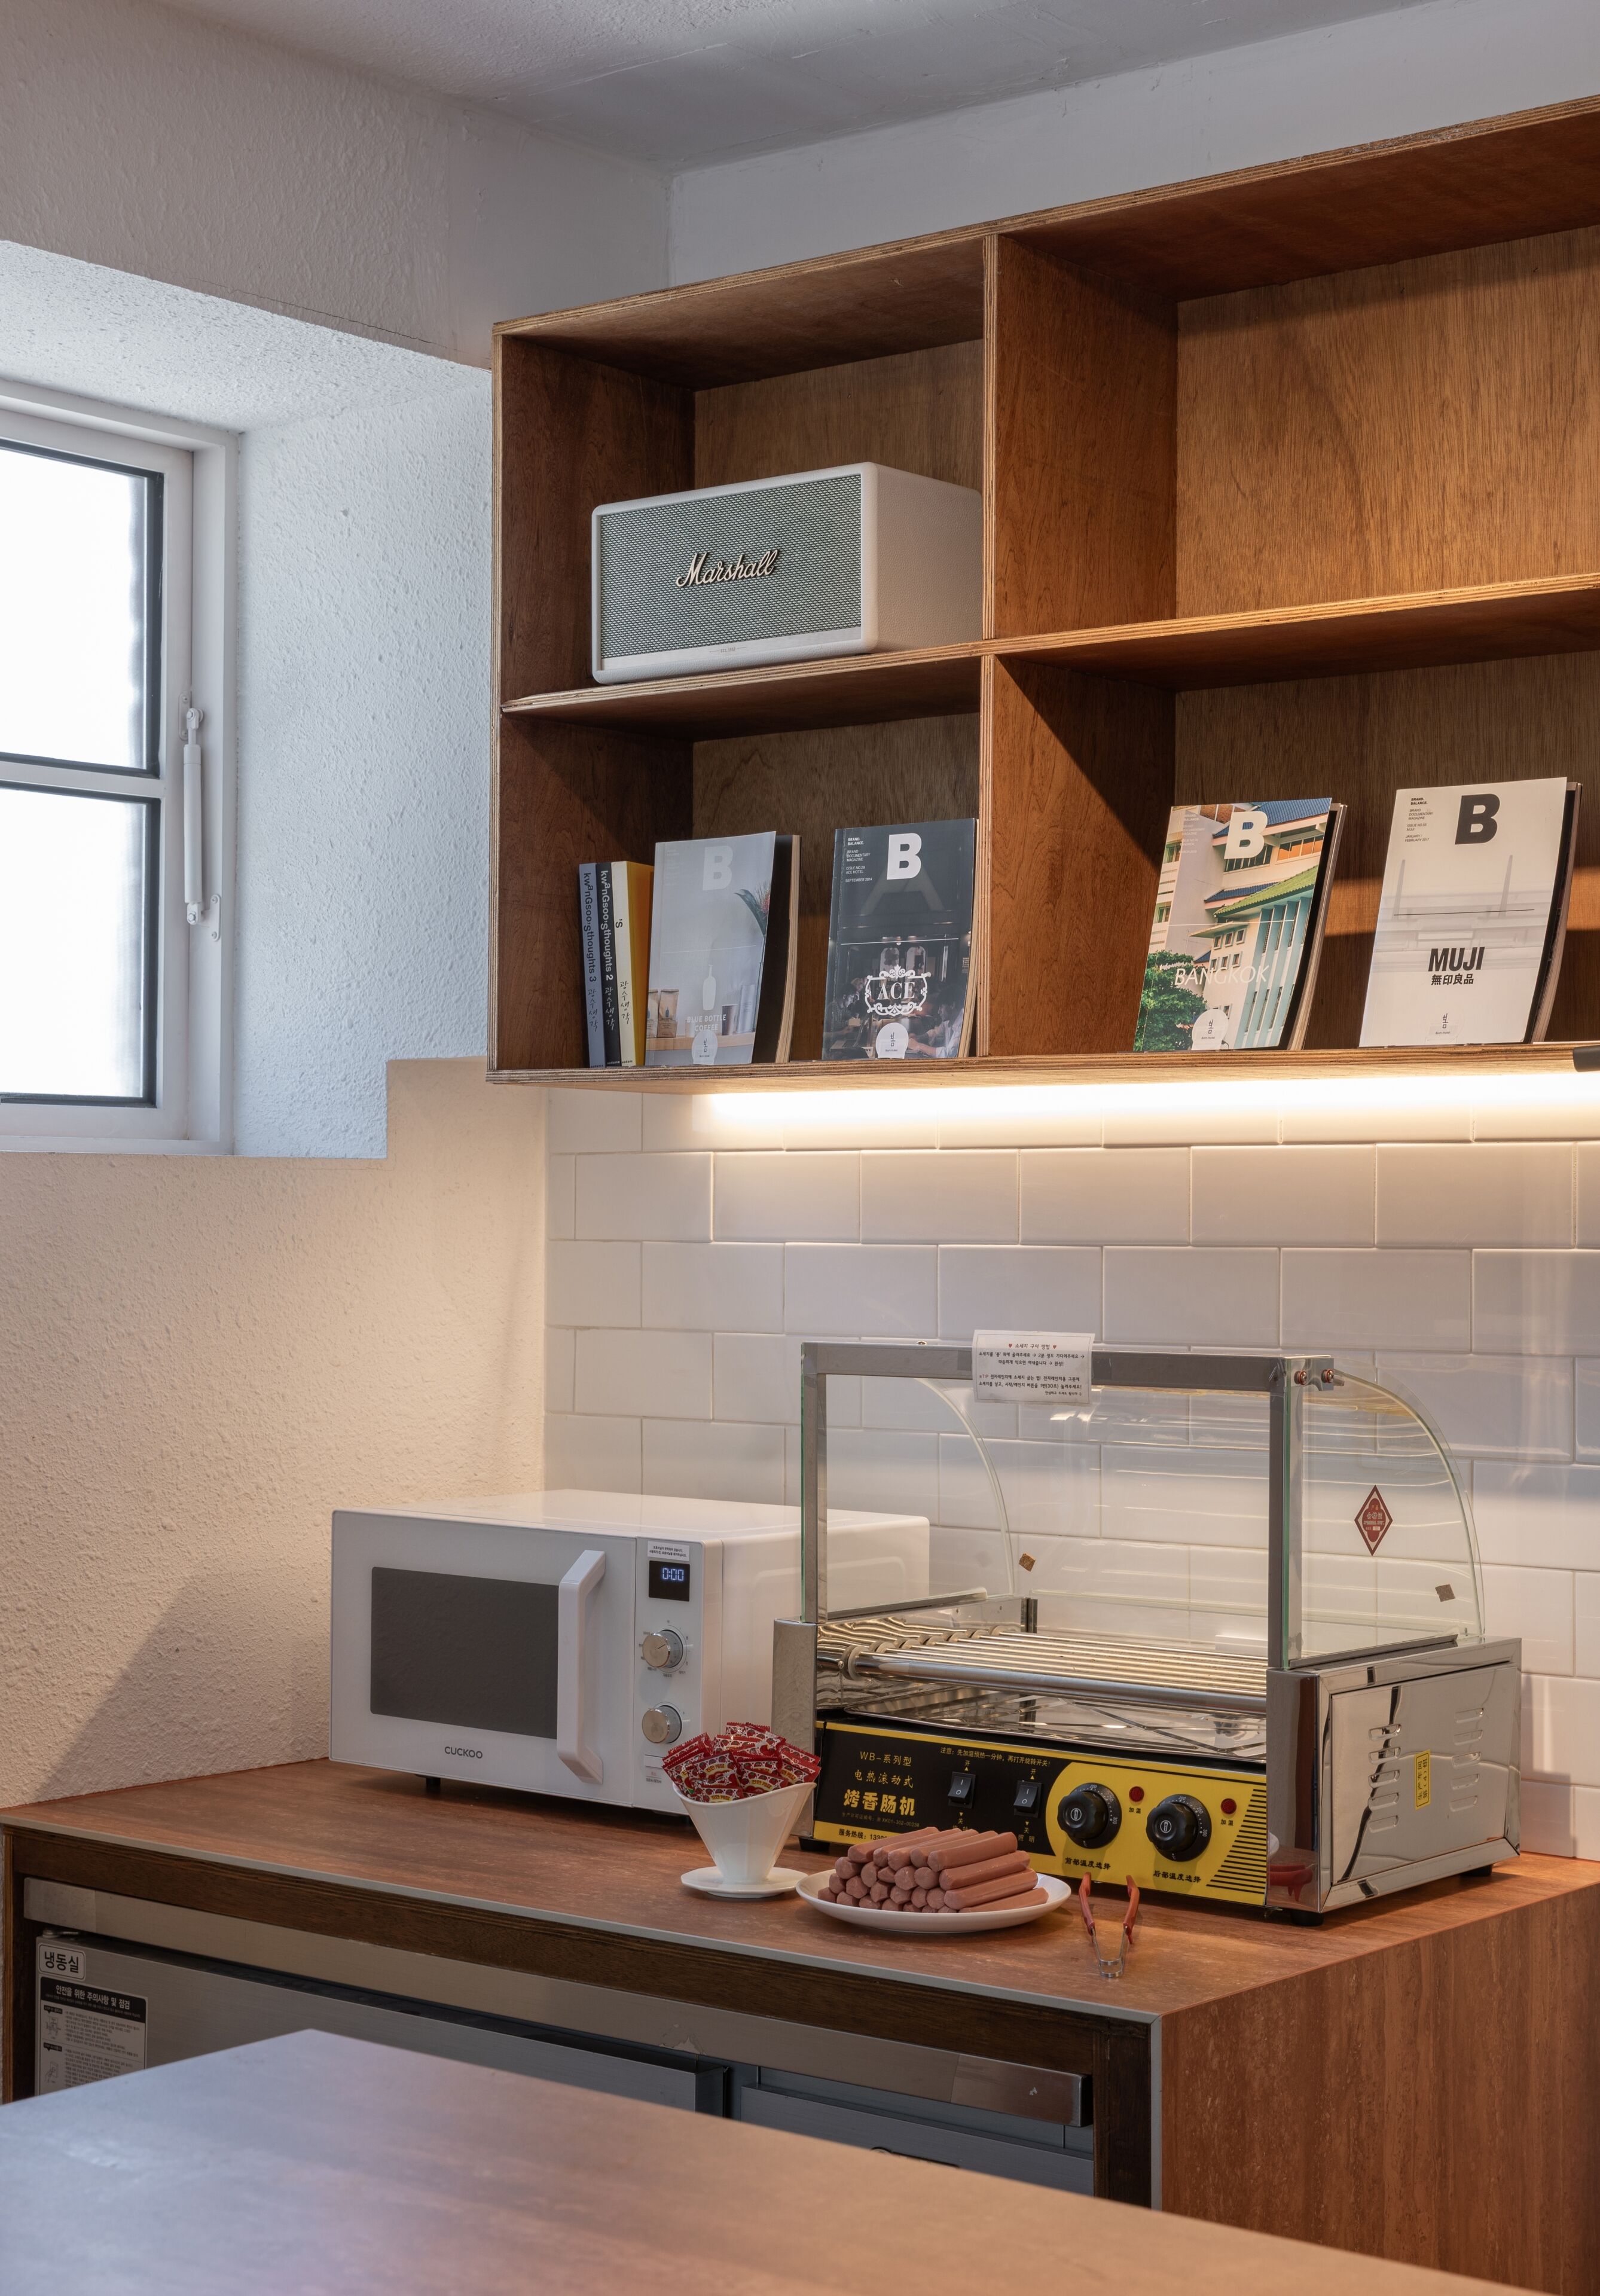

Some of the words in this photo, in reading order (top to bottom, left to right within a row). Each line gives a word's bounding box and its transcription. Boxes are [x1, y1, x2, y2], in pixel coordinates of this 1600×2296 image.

[676, 549, 778, 588] Marshall
[1455, 793, 1500, 845] B
[1224, 811, 1268, 859] B
[887, 832, 922, 880] B
[703, 845, 733, 891] B
[1427, 947, 1485, 972] MUJI
[1174, 965, 1269, 985] BANGKOK
[1431, 973, 1474, 985] 無印良品
[877, 982, 915, 1000] ACE
[662, 1568, 684, 1581] 0:00
[444, 1746, 483, 1758] CUCKOO
[860, 1751, 912, 1766] WB-系列型
[854, 1769, 914, 1788] 电热滚动式
[843, 1789, 915, 1816] 烤香肠机
[1065, 1857, 1111, 1870] 前部温度选择
[1153, 1870, 1201, 1883] 后部温度选择
[44, 1952, 79, 1973] 냉동실
[56, 1984, 72, 1997] 안전을
[74, 1989, 86, 2000] 위한
[87, 1992, 109, 2005] 주의사항
[111, 1998, 117, 2007] 및
[119, 1999, 130, 2010] 점검
